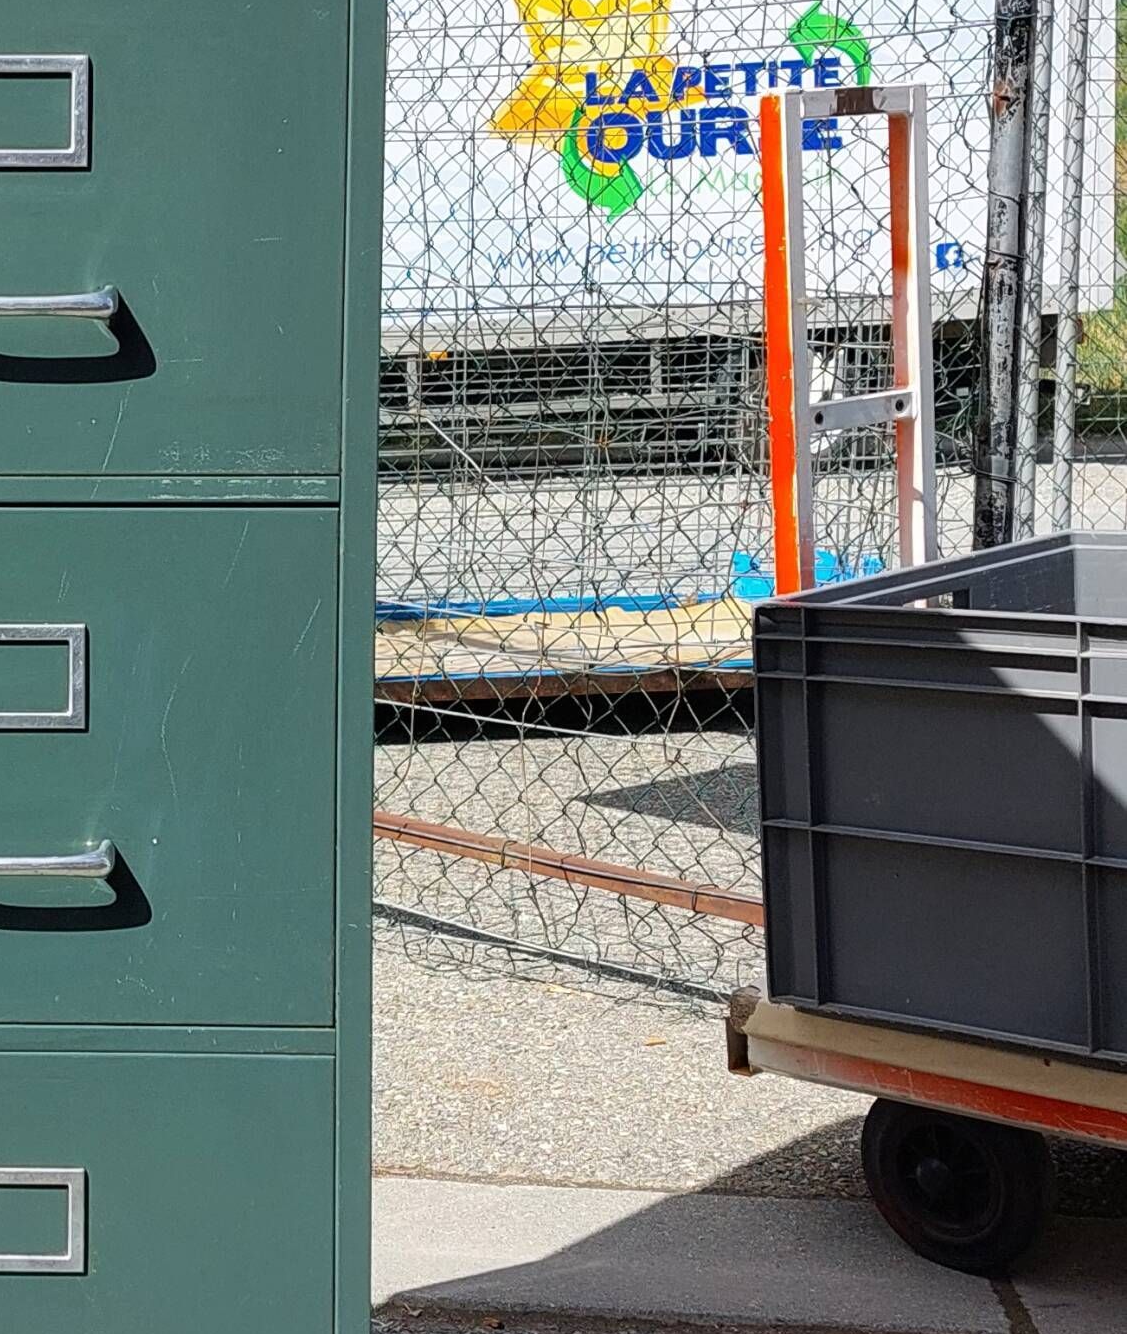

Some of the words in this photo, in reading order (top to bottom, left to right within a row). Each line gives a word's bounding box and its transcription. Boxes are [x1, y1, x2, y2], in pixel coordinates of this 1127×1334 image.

[584, 70, 660, 106] LA
[673, 56, 841, 101] PETITE
[587, 105, 843, 164] OURE
